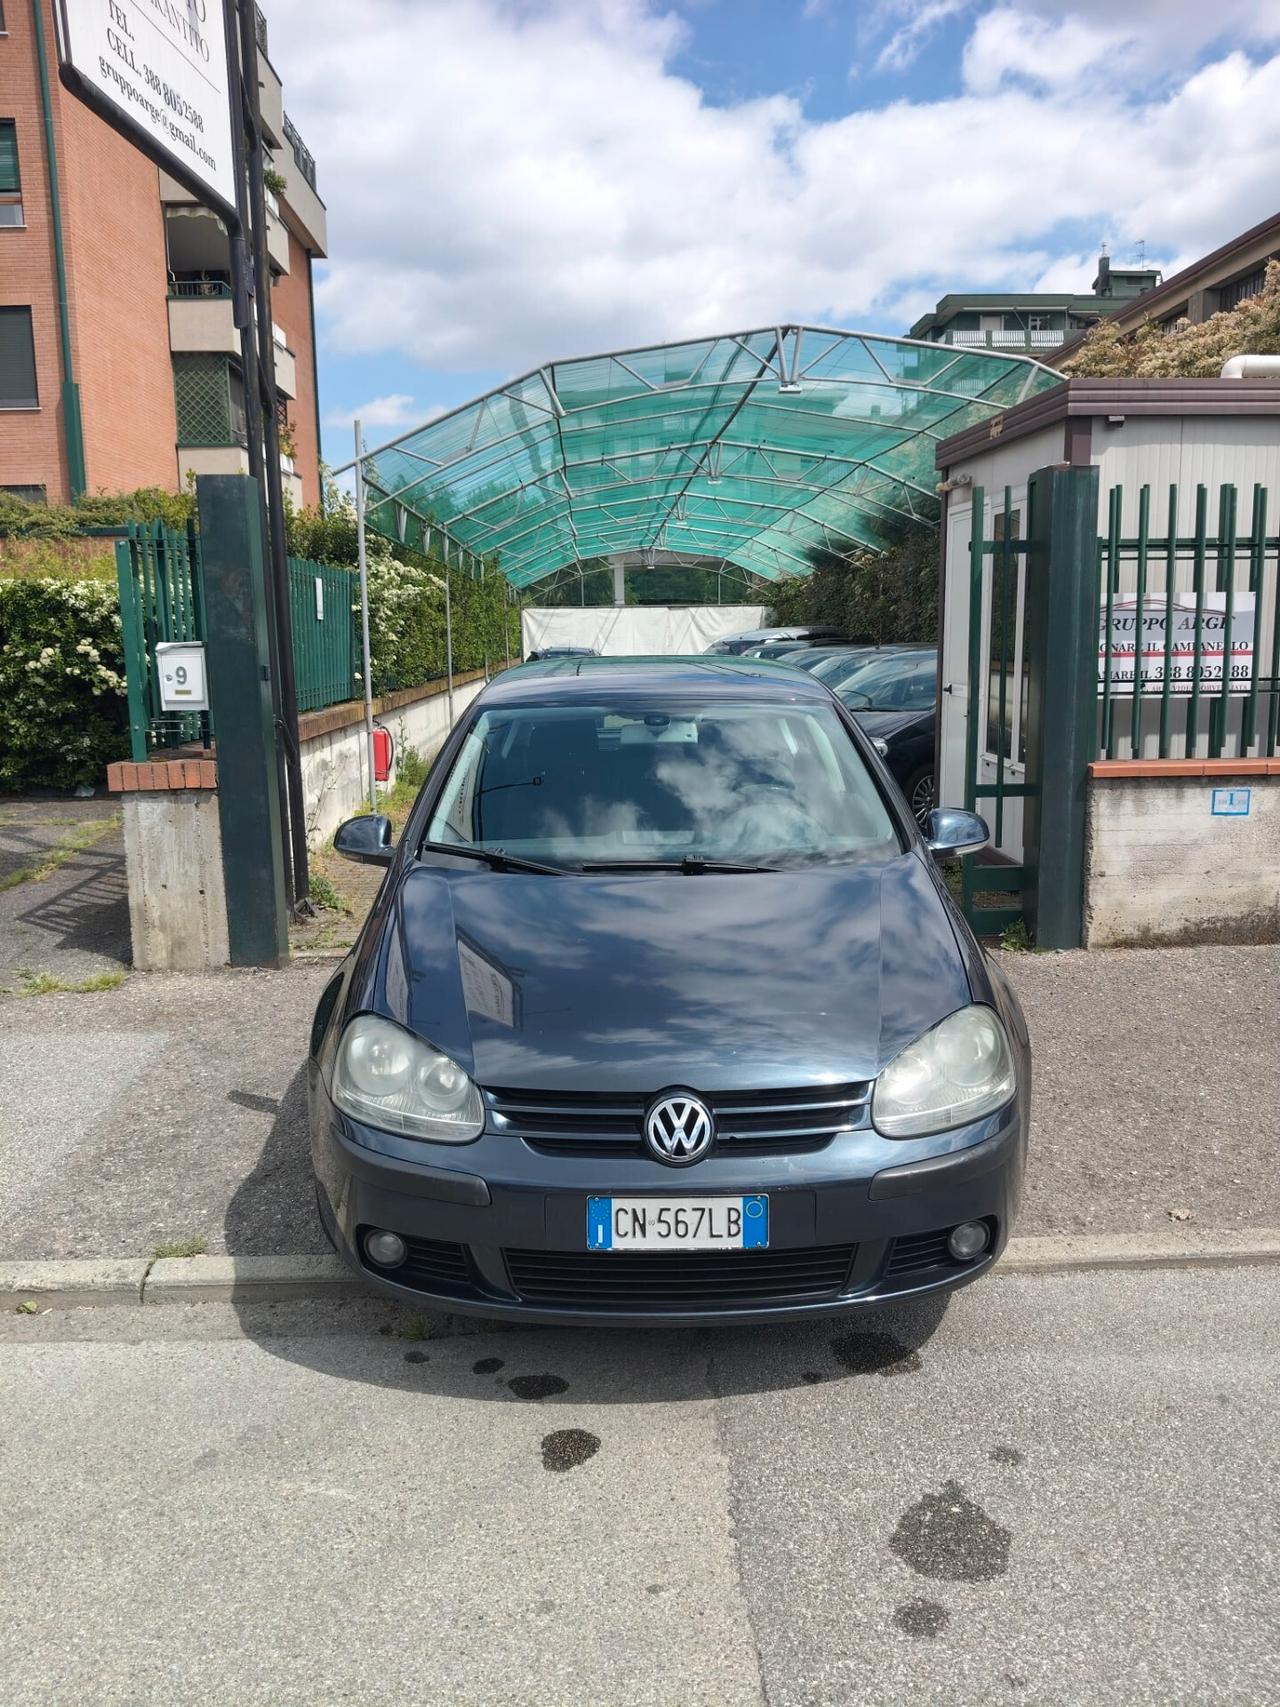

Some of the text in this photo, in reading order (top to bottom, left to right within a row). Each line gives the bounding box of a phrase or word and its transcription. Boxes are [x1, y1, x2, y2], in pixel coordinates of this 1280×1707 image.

[143, 64, 162, 95] 388
[1147, 642, 1160, 652] IL
[175, 665, 188, 686] 9
[1154, 665, 1182, 679] 38
[1186, 665, 1249, 678] 85288
